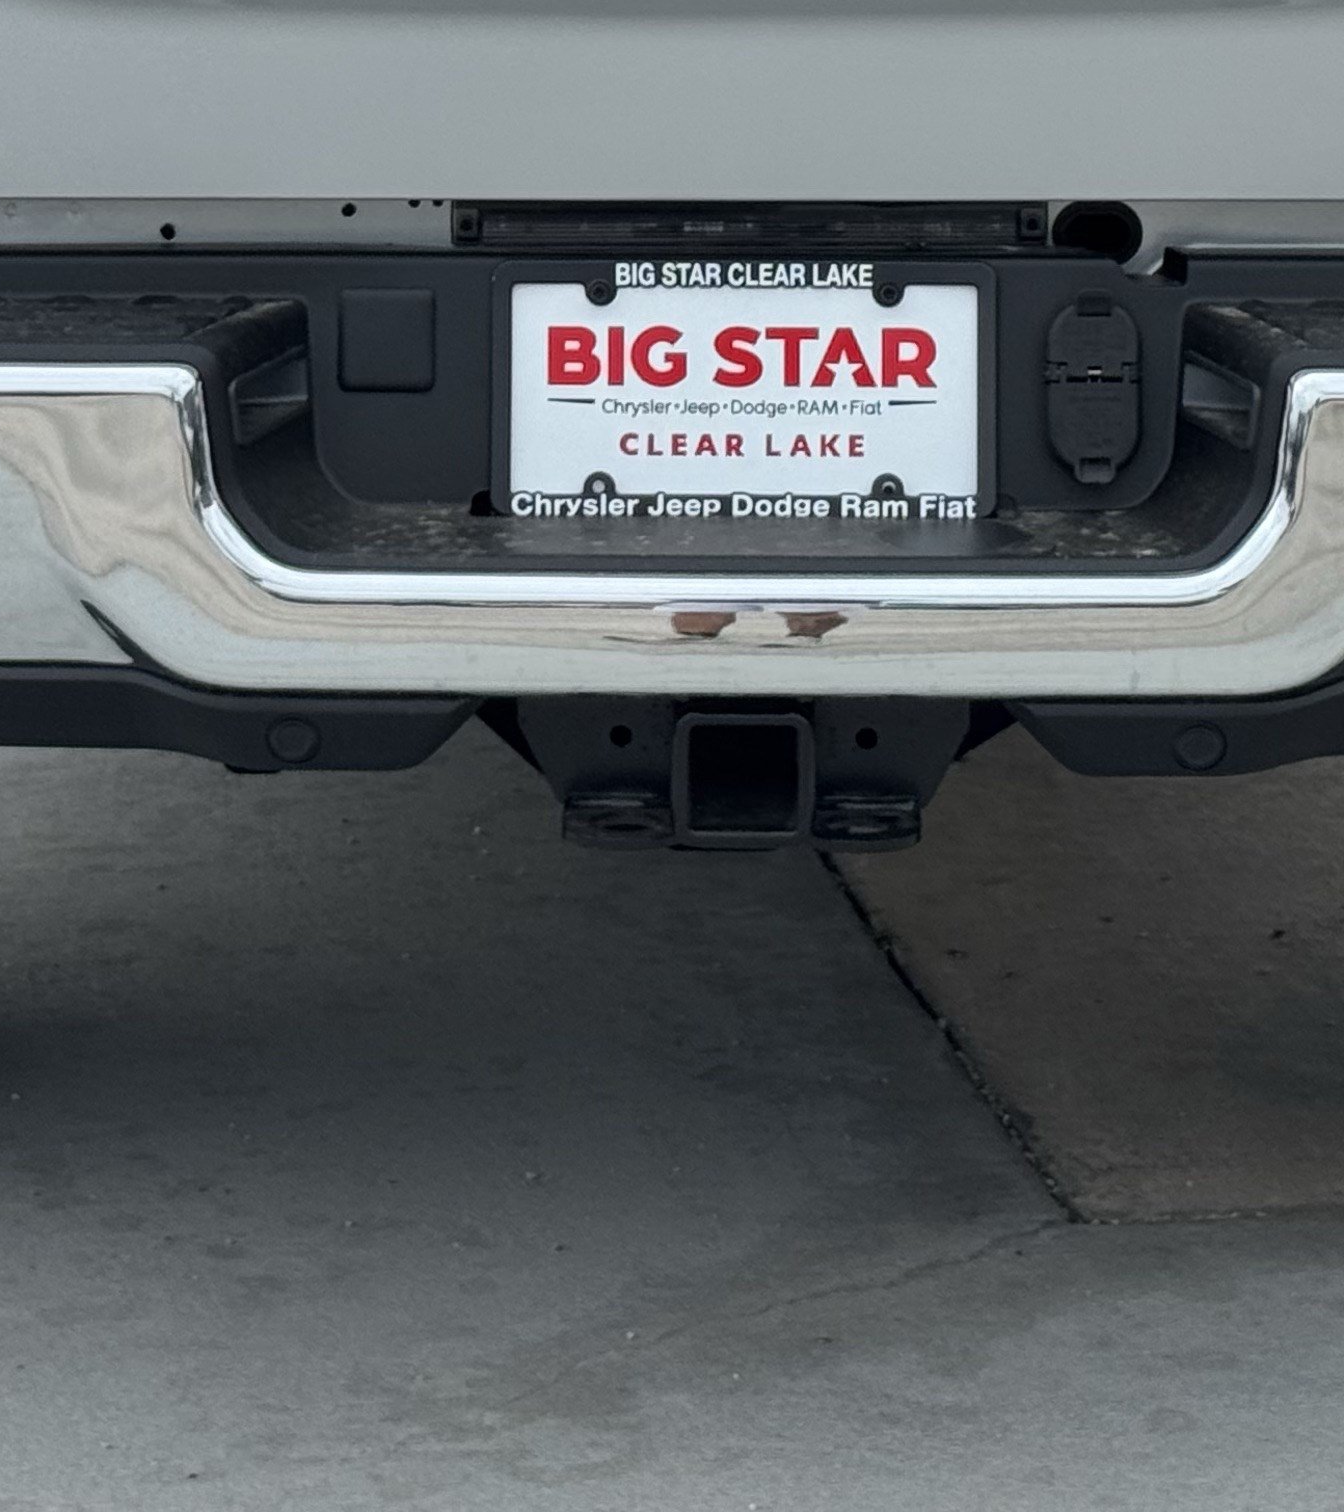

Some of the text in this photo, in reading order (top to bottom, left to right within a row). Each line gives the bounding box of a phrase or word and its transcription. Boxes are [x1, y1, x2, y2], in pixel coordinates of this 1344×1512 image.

[615, 262, 873, 287] BIG STAR CLEAR LAKE
[548, 325, 937, 388] BIG STAR
[602, 398, 882, 418] Chrysler Jeep Dodge RAM Fiat
[619, 432, 865, 457] CLEAR LAKE
[511, 493, 977, 519] Chrysler Jeep Dodge Ram Fiat
